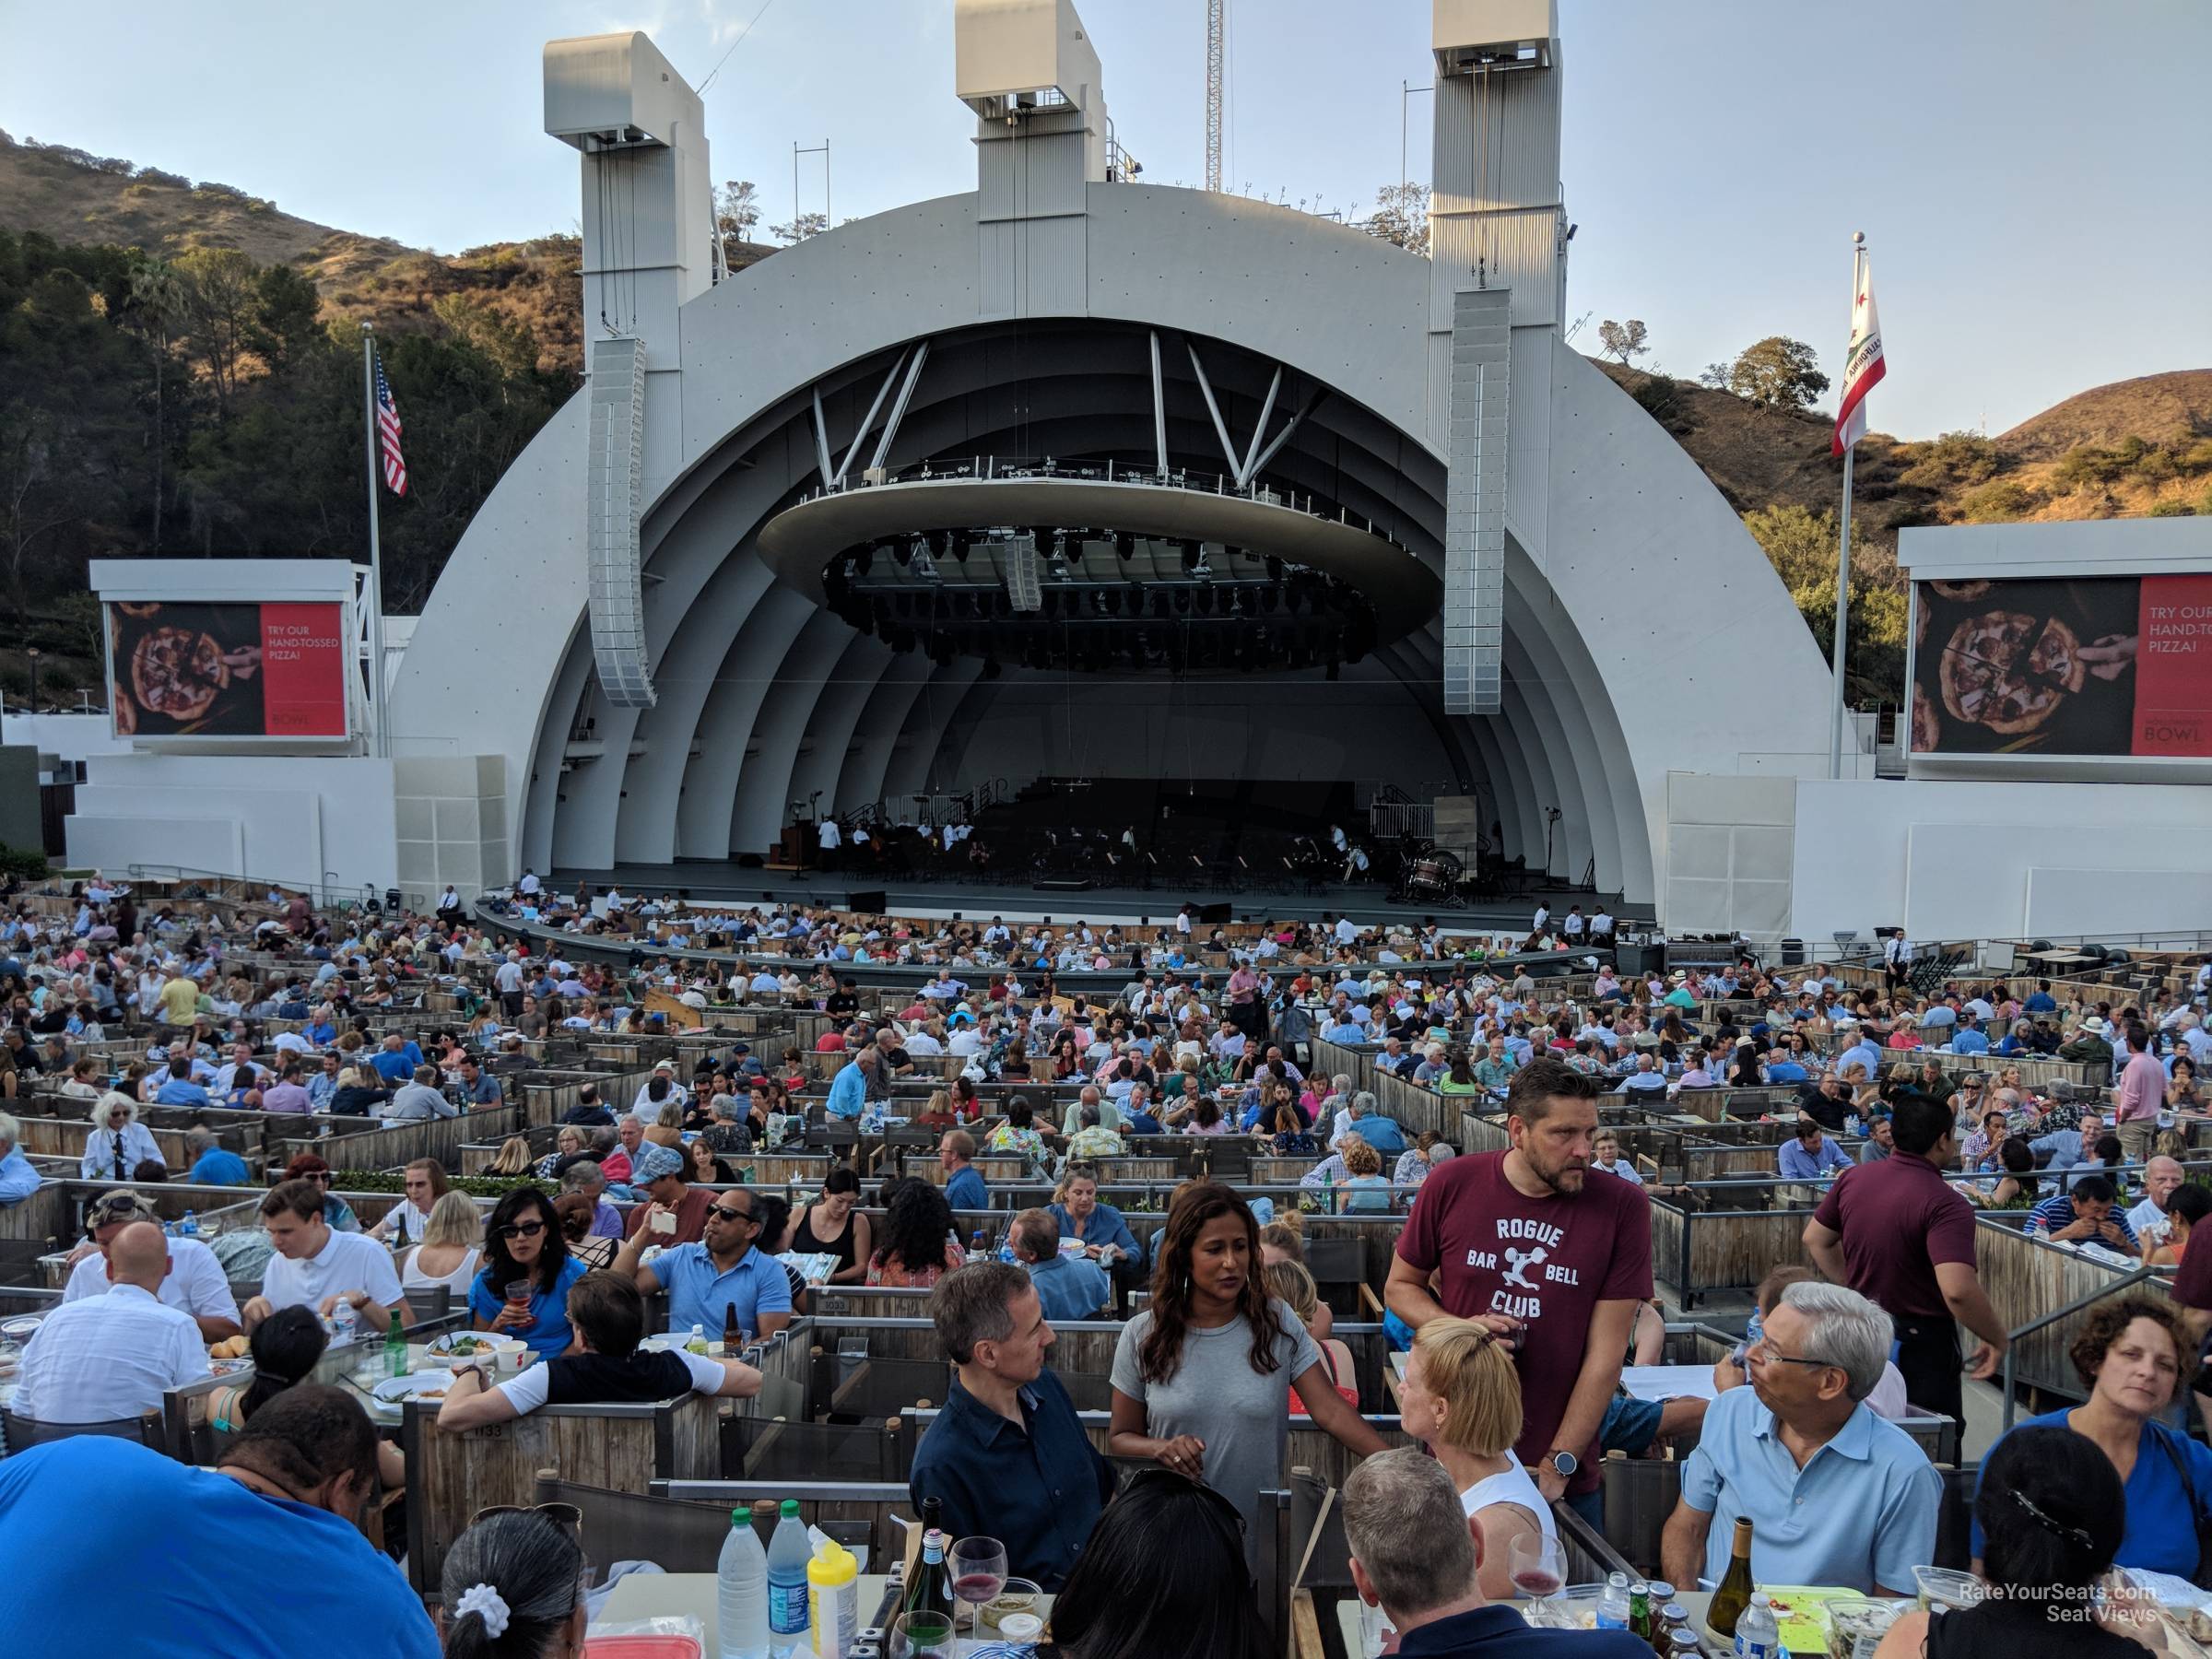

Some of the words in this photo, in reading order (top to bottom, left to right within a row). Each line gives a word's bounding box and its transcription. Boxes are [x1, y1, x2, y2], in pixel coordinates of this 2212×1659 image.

[2149, 607, 2176, 618] TRY
[267, 626, 284, 635] TRY
[287, 626, 310, 635] OUR
[268, 638, 339, 648] HAND-TOSSED
[2149, 641, 2197, 653] PIZZA!
[269, 651, 300, 660] PIZZA!
[2145, 727, 2204, 742] BOWL
[1497, 1218, 1565, 1248] ROGUE
[1466, 1249, 1497, 1270] BAR
[1545, 1264, 1579, 1286] BELL
[1490, 1290, 1541, 1318] CLUB
